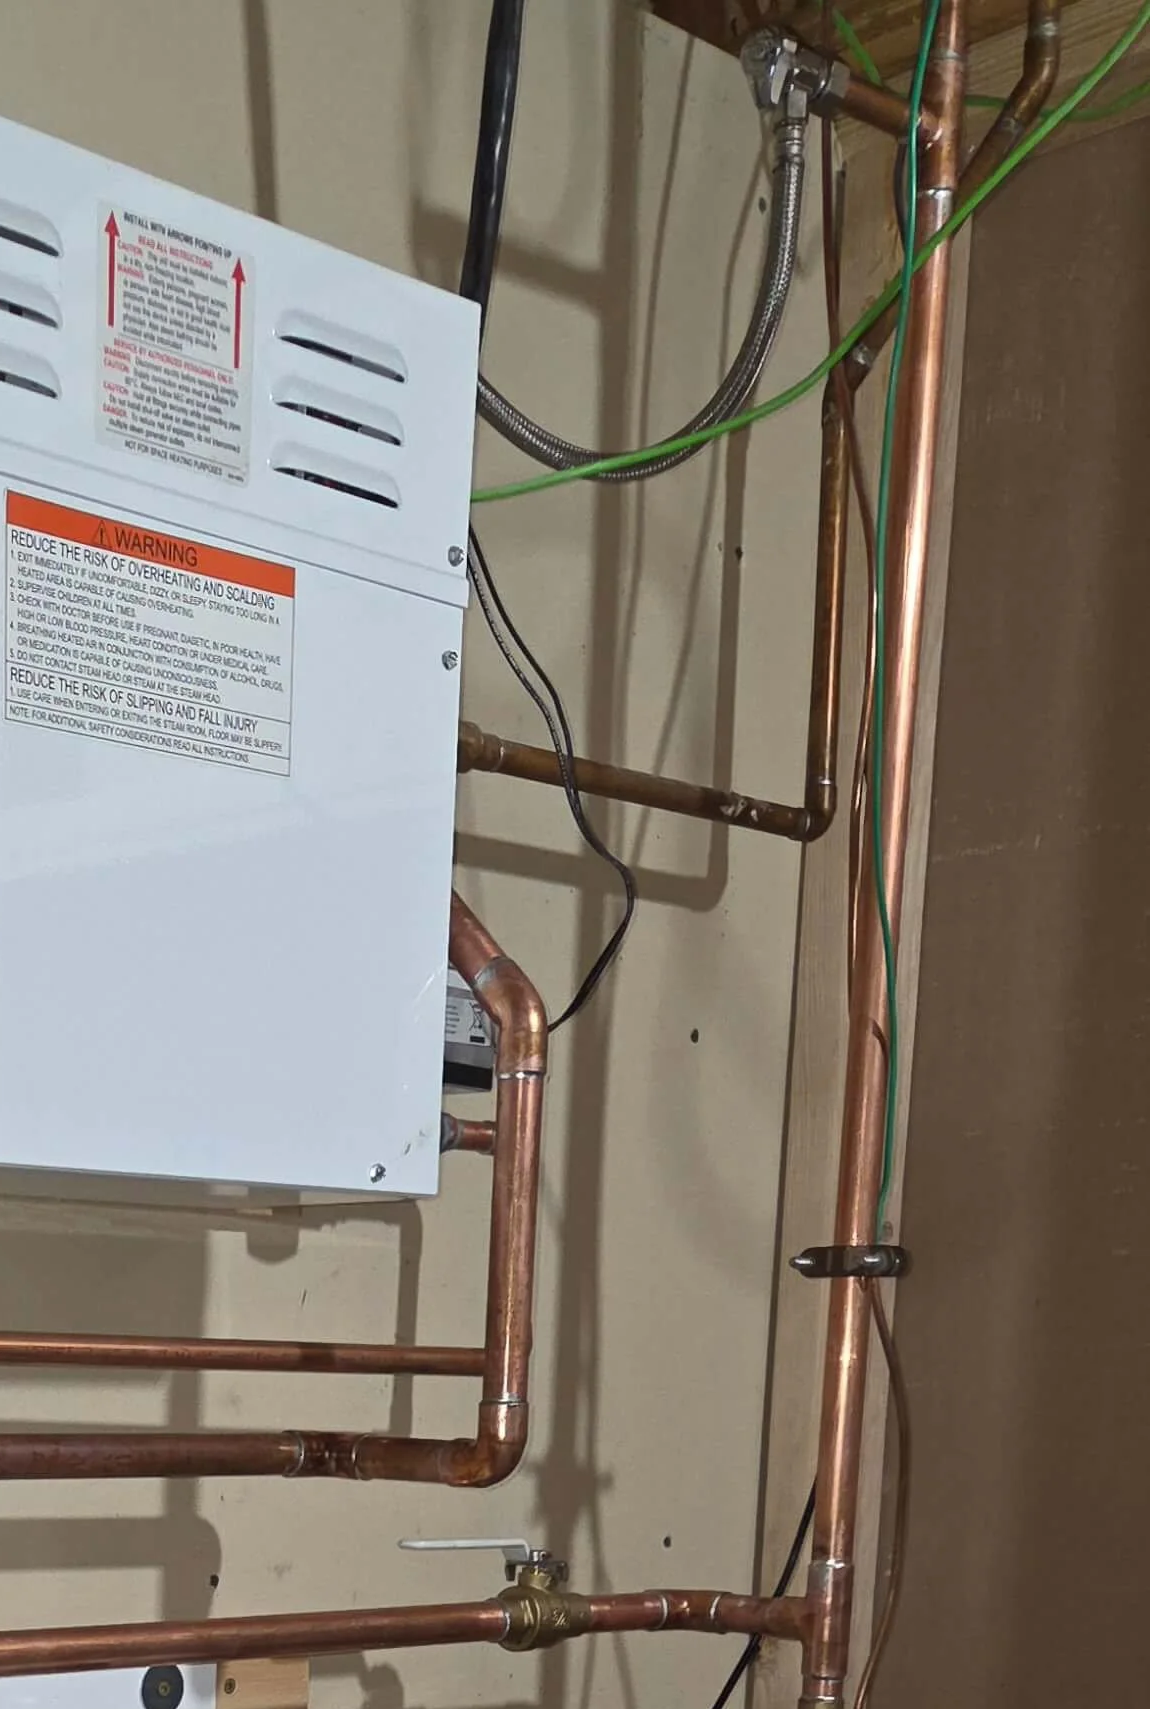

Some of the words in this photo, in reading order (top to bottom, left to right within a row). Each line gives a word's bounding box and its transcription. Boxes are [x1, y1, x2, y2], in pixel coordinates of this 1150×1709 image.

[124, 212, 148, 229] INSTALL
[167, 227, 193, 245] ARROWS
[11, 529, 56, 555] REDUCE
[59, 542, 81, 561] THE
[84, 548, 107, 568] RISK
[110, 555, 125, 572] OF
[128, 560, 200, 592] OVERHEATING
[204, 579, 224, 598] AND
[225, 585, 274, 611] SCALDING
[114, 526, 197, 568] WARNING
[17, 551, 33, 564] EXIT
[35, 555, 78, 576] IMMEDIATELY
[80, 567, 86, 578] IF
[170, 590, 180, 601] OR
[208, 599, 234, 615] STAYING
[236, 606, 248, 618] TOO
[250, 610, 266, 623] LONG
[268, 614, 274, 625] IN
[17, 579, 55, 598] SUPERVISE
[58, 589, 91, 607] CHILDREN
[92, 597, 100, 609] AT
[102, 600, 113, 612] ALL
[18, 565, 44, 581] HEATED
[46, 572, 65, 586] AREA
[66, 577, 71, 588] IS
[74, 579, 103, 596] CAPABLE
[105, 587, 114, 599] OF
[116, 590, 145, 606] CAUSING
[17, 593, 41, 608] CHECK
[43, 599, 60, 612] WITH
[62, 604, 89, 619] DOCTOR
[92, 611, 118, 626] BEFORE
[121, 618, 132, 630] USE
[136, 622, 141, 632] IF
[212, 640, 218, 650] IN
[220, 642, 238, 655] POOR
[265, 653, 280, 665] HAVE
[17, 608, 33, 621] HIGH
[36, 612, 46, 624] OR
[47, 615, 63, 628] LOW
[65, 619, 88, 633] BLOOD
[129, 634, 150, 648] HEART
[152, 639, 188, 657] CONDITION
[189, 648, 198, 659] OR
[200, 651, 222, 665] UNDER
[223, 656, 249, 671] MEDICAL
[17, 622, 55, 639] BREATHING
[58, 631, 82, 646] HEATED
[85, 638, 96, 649] AIR
[99, 641, 104, 651] IN
[106, 642, 153, 662] CONJUNCTION
[156, 654, 171, 666] WITH
[172, 658, 218, 677] CONSUMPTION
[220, 669, 227, 679] OF
[17, 636, 27, 647] OR
[29, 639, 70, 657] MEDICATION
[72, 648, 78, 659] IS
[80, 650, 109, 666] CAPABLE
[111, 657, 120, 668] OF
[122, 660, 151, 675] CAUSING
[10, 667, 55, 690] REDUCE
[58, 677, 79, 695] THE
[82, 682, 106, 701] RISK
[109, 688, 123, 704] OF
[126, 692, 172, 715] SLIPPING
[175, 702, 195, 720] AND
[199, 708, 221, 725] FALL
[224, 713, 257, 733] INJURY
[17, 650, 27, 661] DO
[29, 653, 43, 664] NOT
[44, 656, 76, 672] CONTACT
[78, 663, 101, 677] STEAM
[102, 669, 121, 681] HEAD
[122, 673, 131, 684] OR
[133, 676, 155, 689] STEAM
[156, 681, 163, 691] AT
[166, 683, 178, 694] THE
[180, 686, 201, 699] STEAM
[17, 687, 30, 699] USE
[32, 691, 51, 704] CARE
[53, 695, 74, 708] WHEN
[75, 700, 108, 716] ENTERING
[110, 707, 120, 718] OR
[122, 710, 147, 724] EXITING
[149, 715, 161, 727] THE
[163, 718, 184, 731] STEAM
[208, 728, 228, 741] FLOOR
[244, 736, 252, 745] BE
[32, 709, 45, 721] FOR
[48, 713, 85, 729] ADDITIONAL
[88, 721, 113, 735] SAFETY
[115, 726, 171, 746] CONSIDERATIONS
[173, 738, 190, 750] READ
[192, 742, 202, 753] ALL
